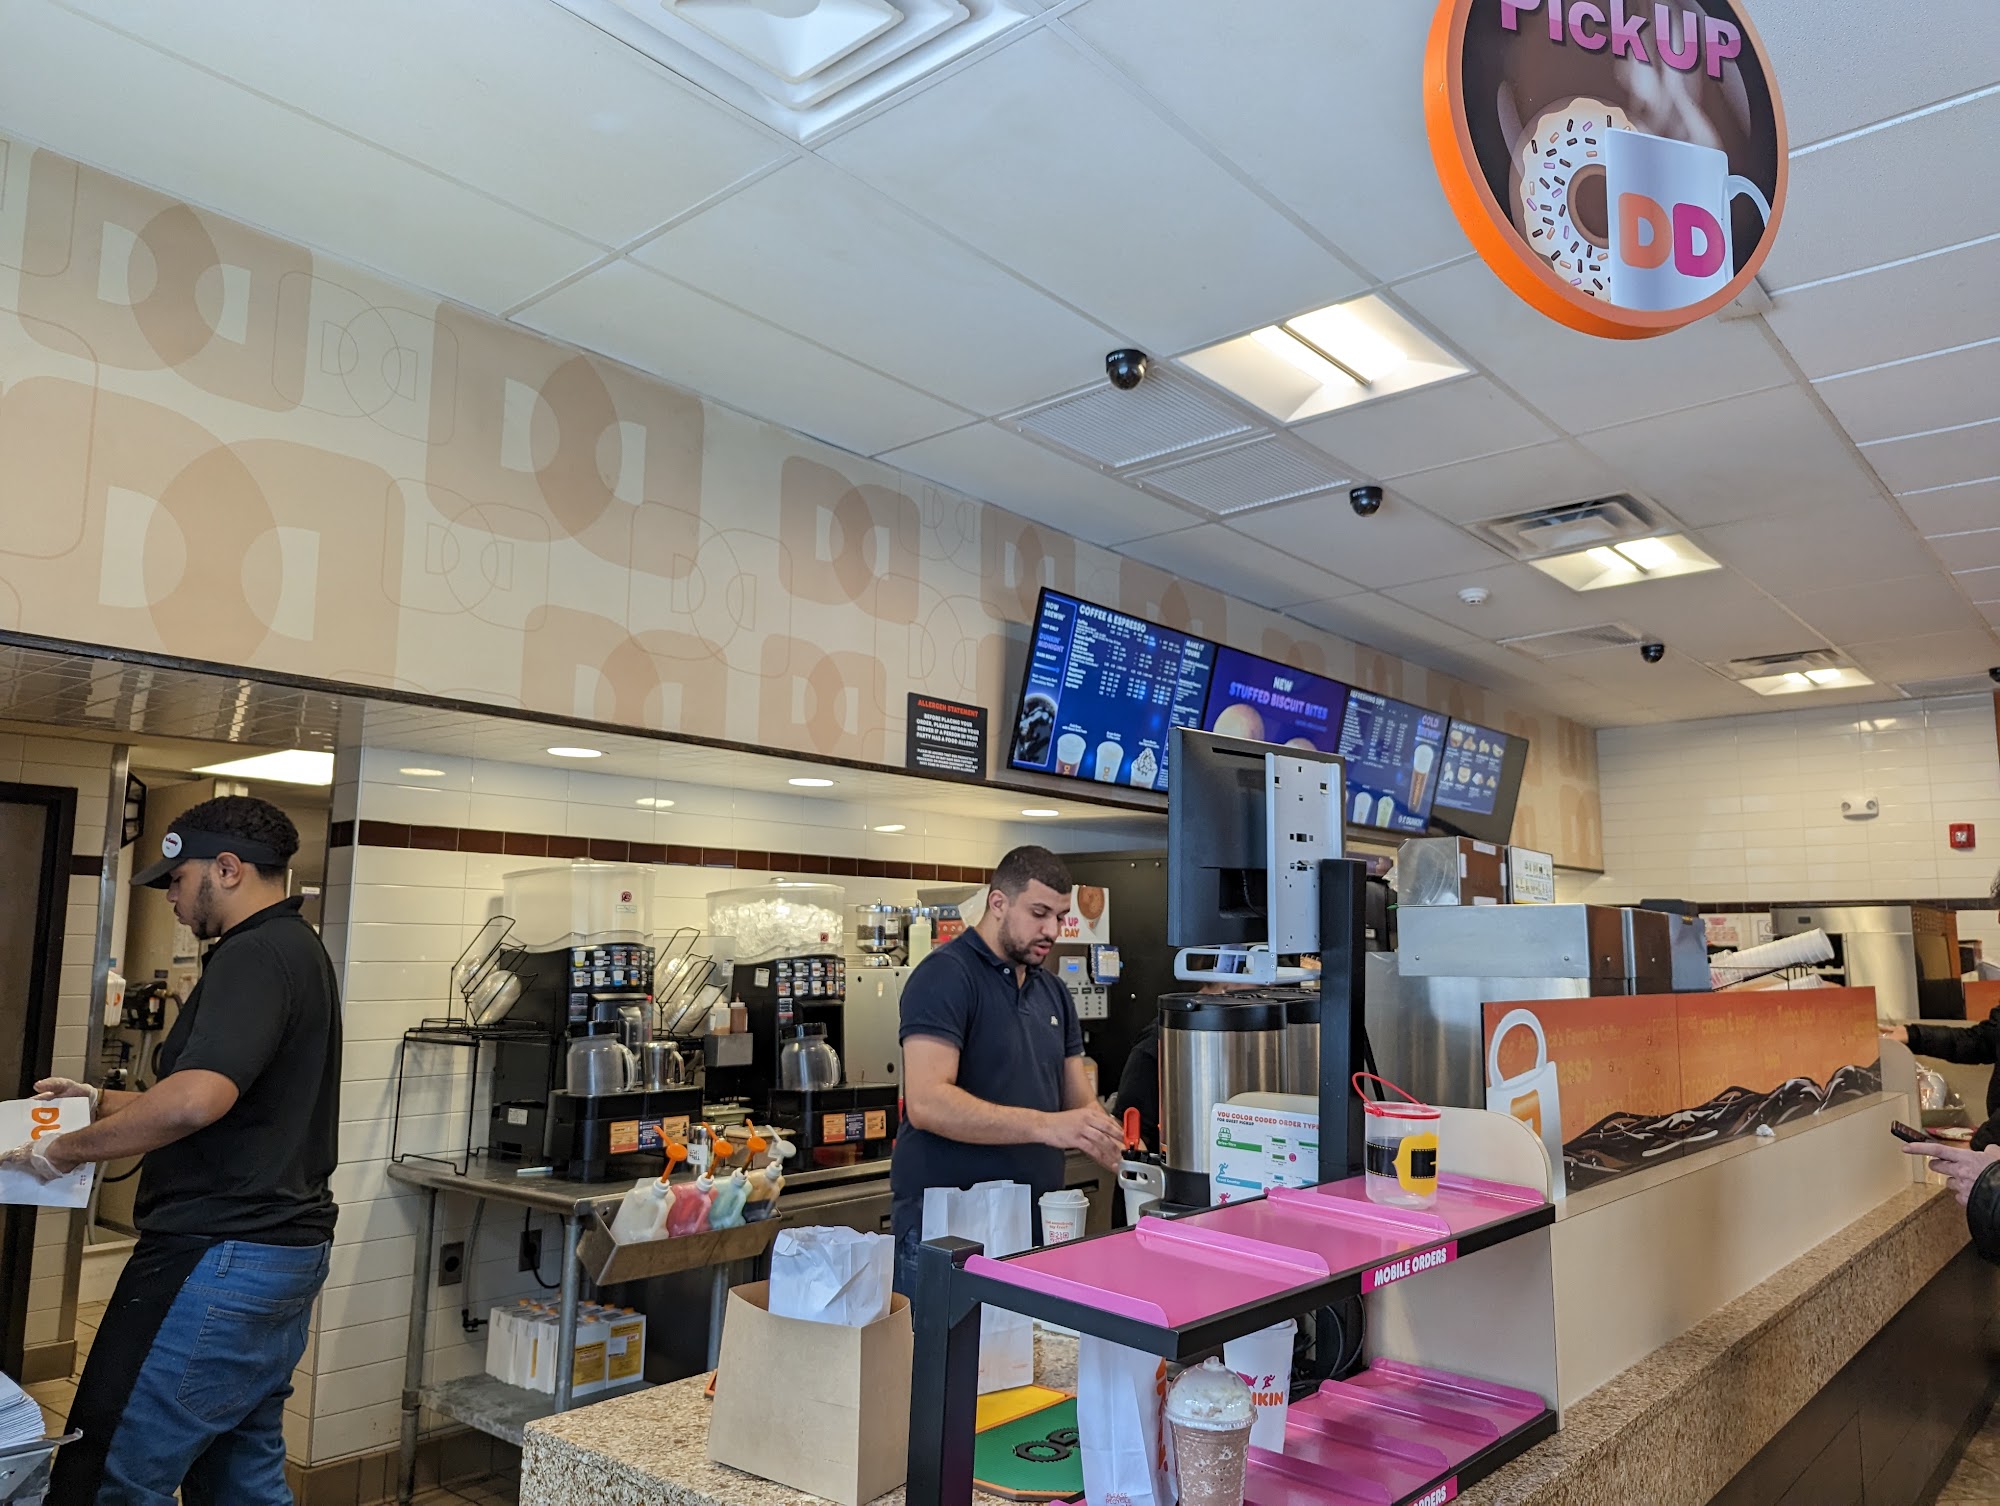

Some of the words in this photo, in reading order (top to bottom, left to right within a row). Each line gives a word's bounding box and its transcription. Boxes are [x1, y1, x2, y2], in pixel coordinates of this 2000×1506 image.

[1617, 191, 1727, 279] DD
[1045, 601, 1059, 612] NOW
[1079, 604, 1106, 622] COFFEE
[1107, 613, 1113, 623] &
[1114, 615, 1147, 633] ESPRESSO
[1039, 632, 1062, 644] DUNKIN'
[1038, 640, 1064, 653] MIDNIGHT
[1184, 648, 1201, 658] YOURS
[1186, 640, 1198, 650] MAKE
[1199, 644, 1205, 652] IT
[1273, 676, 1294, 692] NEW
[1229, 681, 1270, 704] STUFFED
[1270, 693, 1305, 714] BISCUIT
[1304, 703, 1328, 720] BITES
[917, 699, 947, 711] ALLERGEN
[947, 705, 978, 717] STATEMENT
[916, 719, 933, 728] ORDER,
[950, 725, 967, 733] INFORM
[924, 713, 941, 722] BEFORE
[941, 716, 960, 725] PLACING
[1422, 714, 1439, 728] COLD
[916, 732, 931, 740] PARTY
[958, 740, 978, 748] ALLERGY.
[943, 730, 960, 738] PERSON
[1068, 917, 1078, 927] UP
[1064, 928, 1080, 938] DAY
[1231, 1113, 1253, 1122] COLOR
[1254, 1116, 1277, 1124] CODED
[1278, 1119, 1302, 1128] ORDER
[1374, 1262, 1411, 1288] MOBILE
[1411, 1247, 1448, 1274] ORDERS
